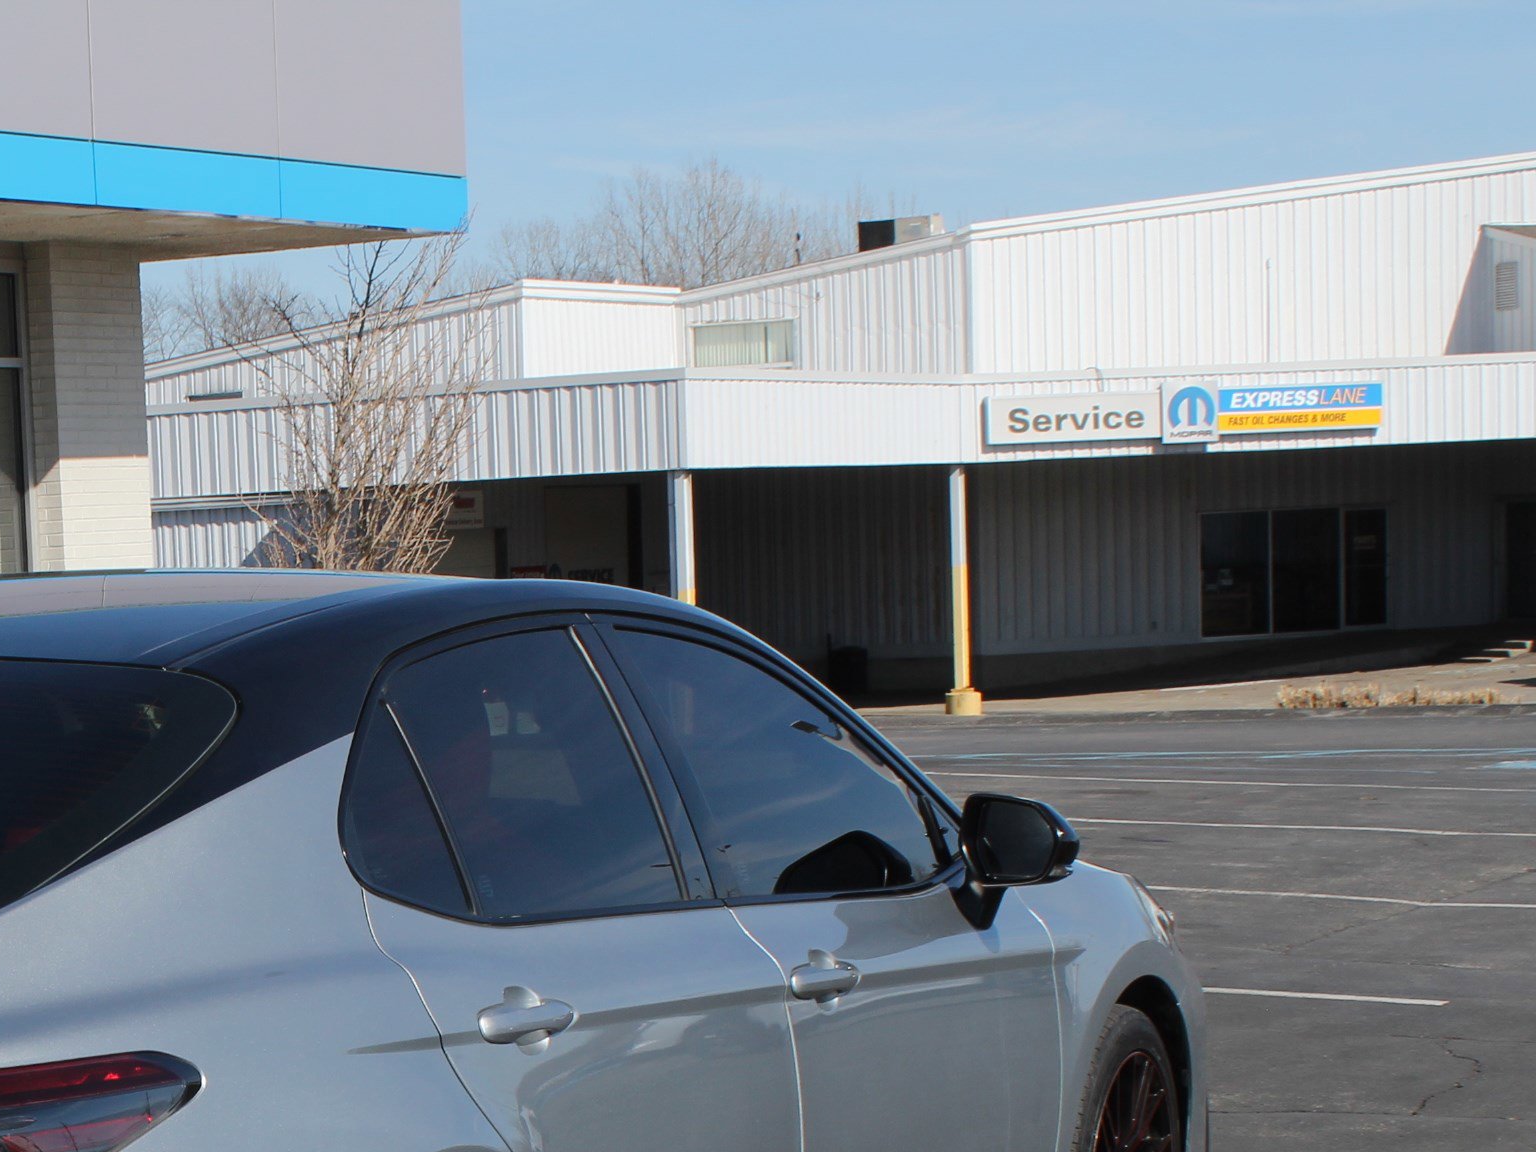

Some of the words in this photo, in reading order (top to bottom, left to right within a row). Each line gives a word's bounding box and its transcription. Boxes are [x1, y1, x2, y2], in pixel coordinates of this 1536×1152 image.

[1007, 404, 1146, 435] Service
[1228, 416, 1249, 426] FAST
[1252, 415, 1265, 426] OIL
[1268, 414, 1309, 425] CHANGES
[1311, 414, 1318, 423] &
[1321, 413, 1348, 423] MORE
[1170, 430, 1213, 438] MOPAR
